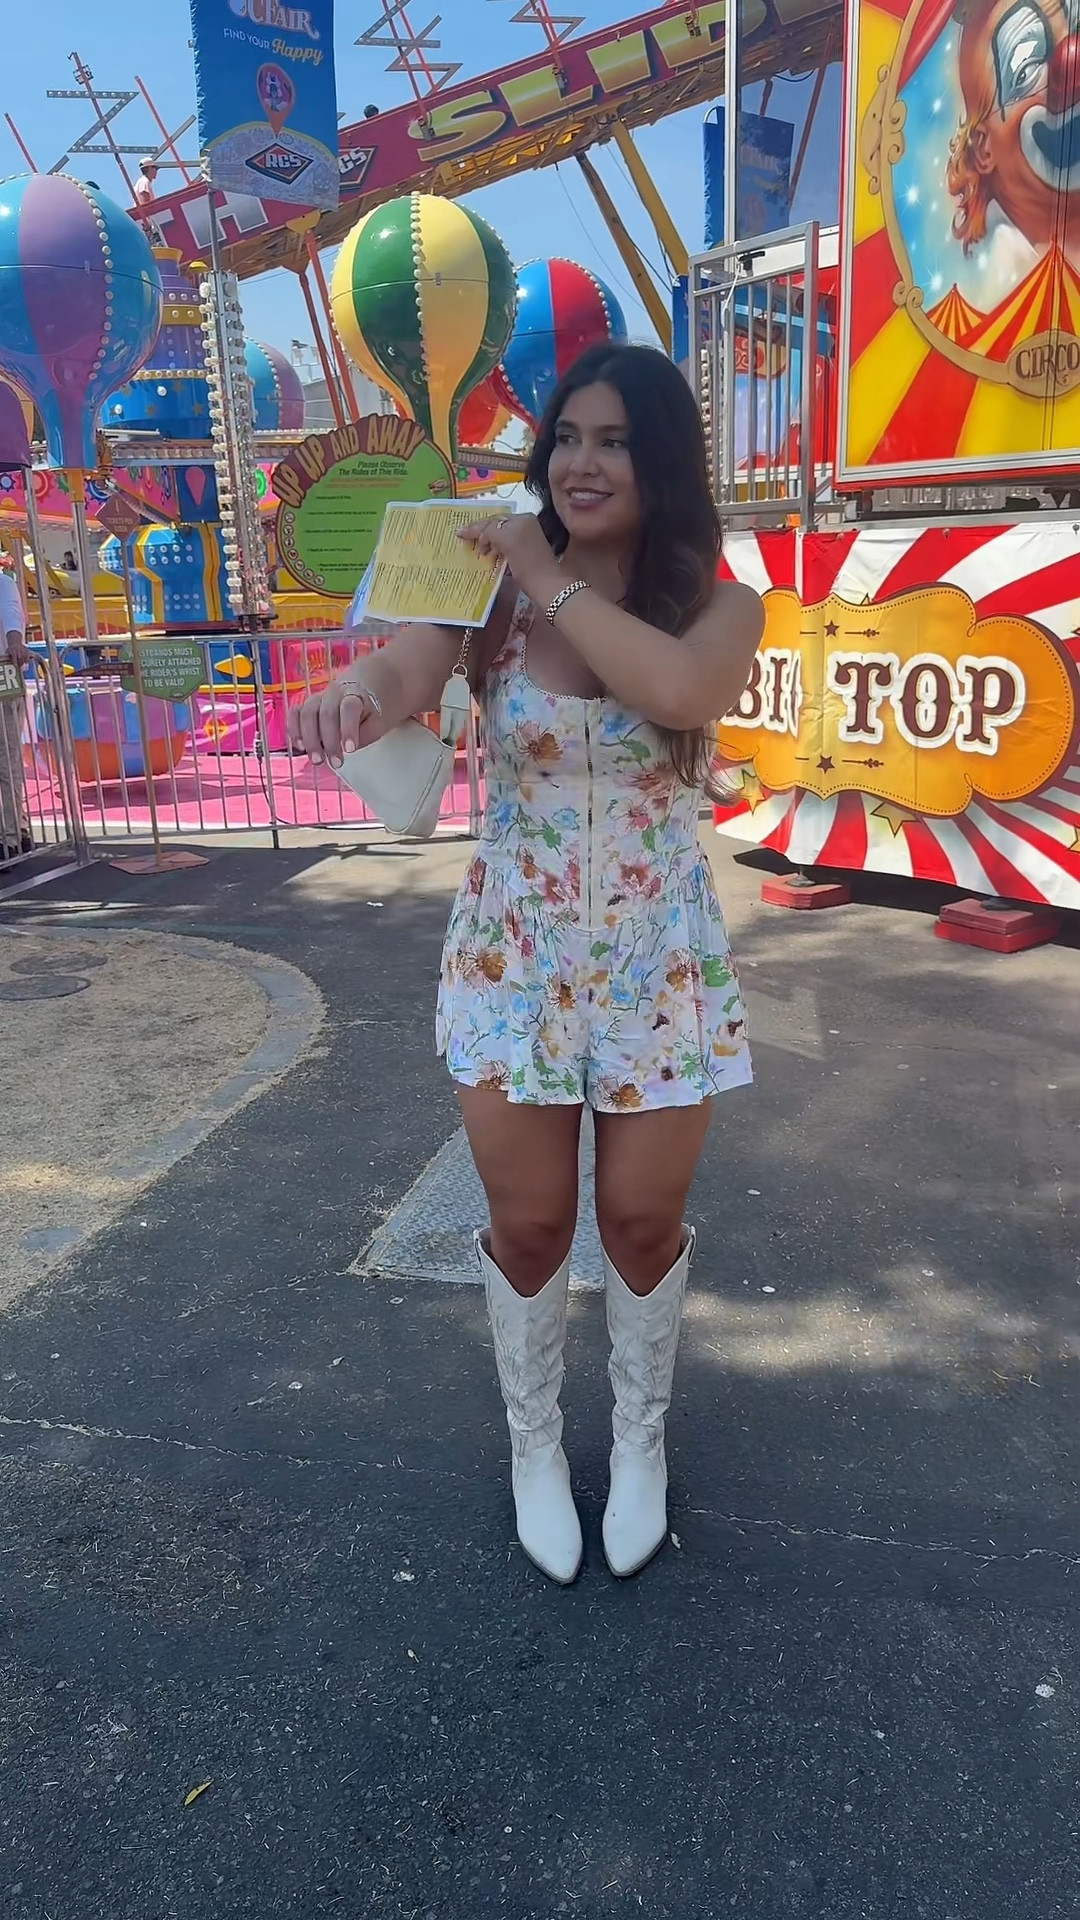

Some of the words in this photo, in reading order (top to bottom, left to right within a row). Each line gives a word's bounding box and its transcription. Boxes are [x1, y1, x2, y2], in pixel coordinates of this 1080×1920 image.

[223, 28, 246, 40] FIND
[245, 34, 270, 49] YOUR
[271, 38, 324, 66] Happy
[271, 463, 307, 508] UP
[295, 434, 328, 481] UP
[329, 424, 360, 461] AND
[365, 412, 426, 461] AWAY
[338, 468, 350, 476] The
[350, 468, 369, 476] Rules
[370, 468, 378, 476] of
[378, 468, 392, 476] This
[173, 647, 193, 656] MUST
[168, 658, 202, 666] ATTACHED
[150, 668, 178, 677] RIDER'S
[179, 667, 200, 676] WRIST
[144, 679, 153, 688] TO
[154, 679, 164, 687] BE
[165, 678, 185, 687] VALID
[830, 656, 1021, 750] TOP
